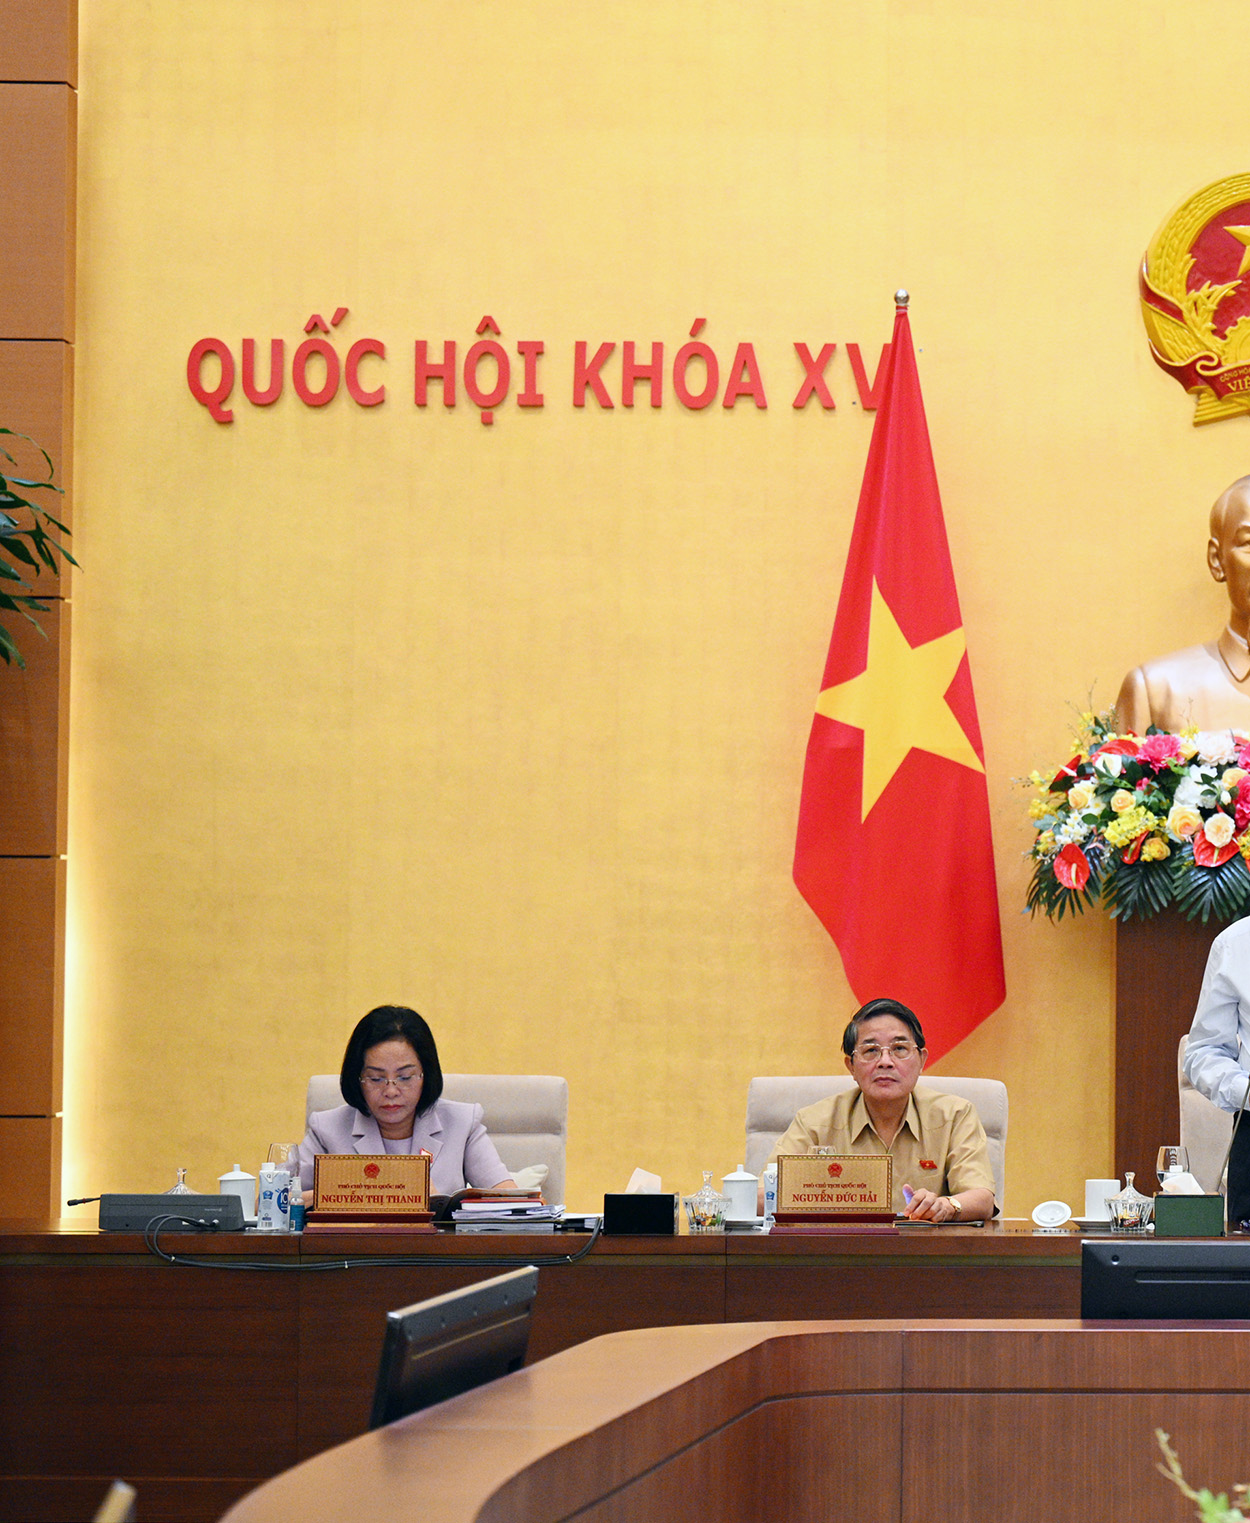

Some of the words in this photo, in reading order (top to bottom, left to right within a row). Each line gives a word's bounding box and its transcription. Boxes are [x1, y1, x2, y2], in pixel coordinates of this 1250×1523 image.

[186, 307, 386, 425] QUỐC
[414, 315, 545, 426] HỘI
[572, 318, 768, 411] KHÓA
[792, 342, 893, 410] XV
[321, 1190, 363, 1203] NGUYỄN
[366, 1195, 384, 1205] THỊ
[386, 1195, 421, 1203] THANH
[792, 1190, 834, 1202] NGUYỄN
[836, 1191, 857, 1202] ĐỨC
[859, 1190, 877, 1202] HẢI
